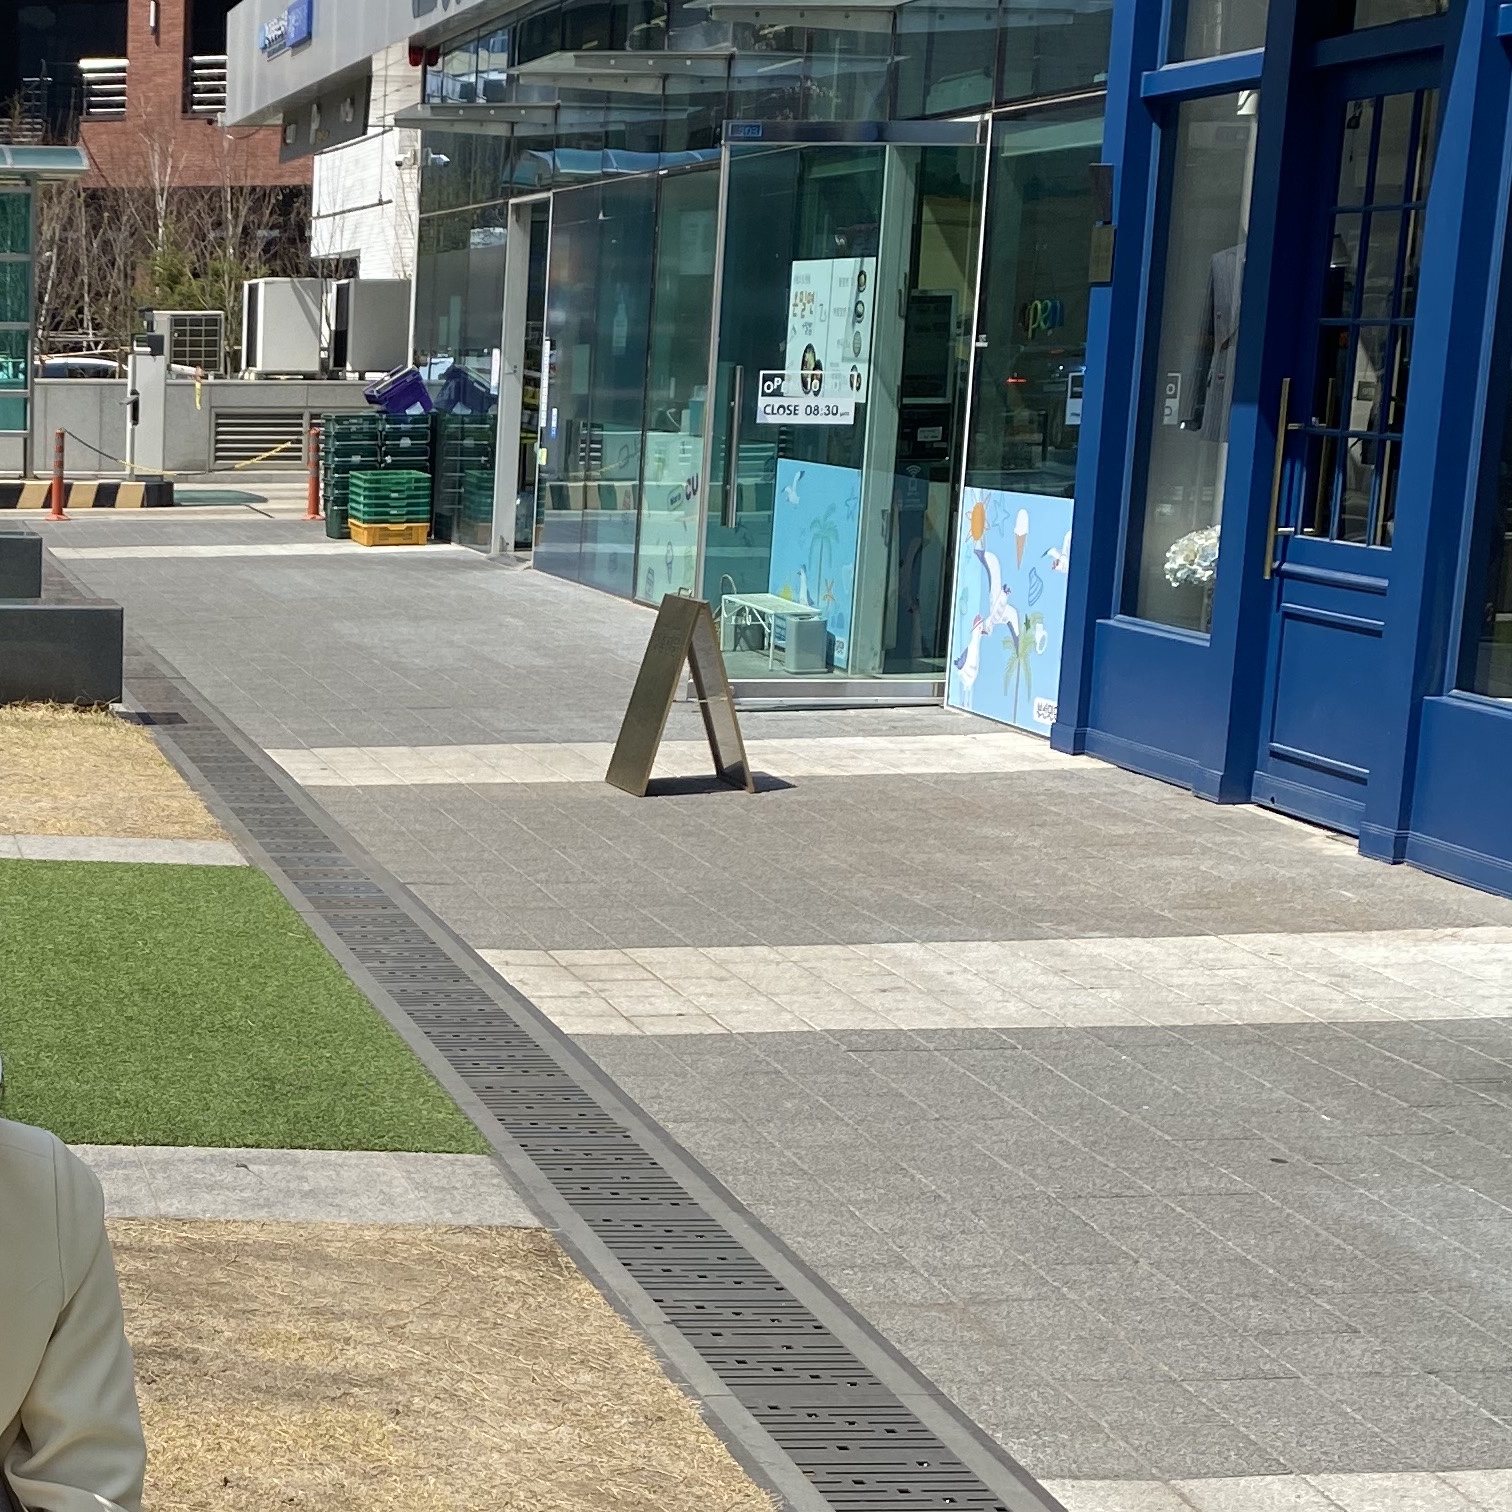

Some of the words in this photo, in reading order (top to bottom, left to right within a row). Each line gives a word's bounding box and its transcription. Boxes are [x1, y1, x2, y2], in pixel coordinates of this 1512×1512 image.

[763, 404, 799, 416] CLOSE
[804, 404, 839, 416] 08:30
[685, 472, 699, 501] CU
